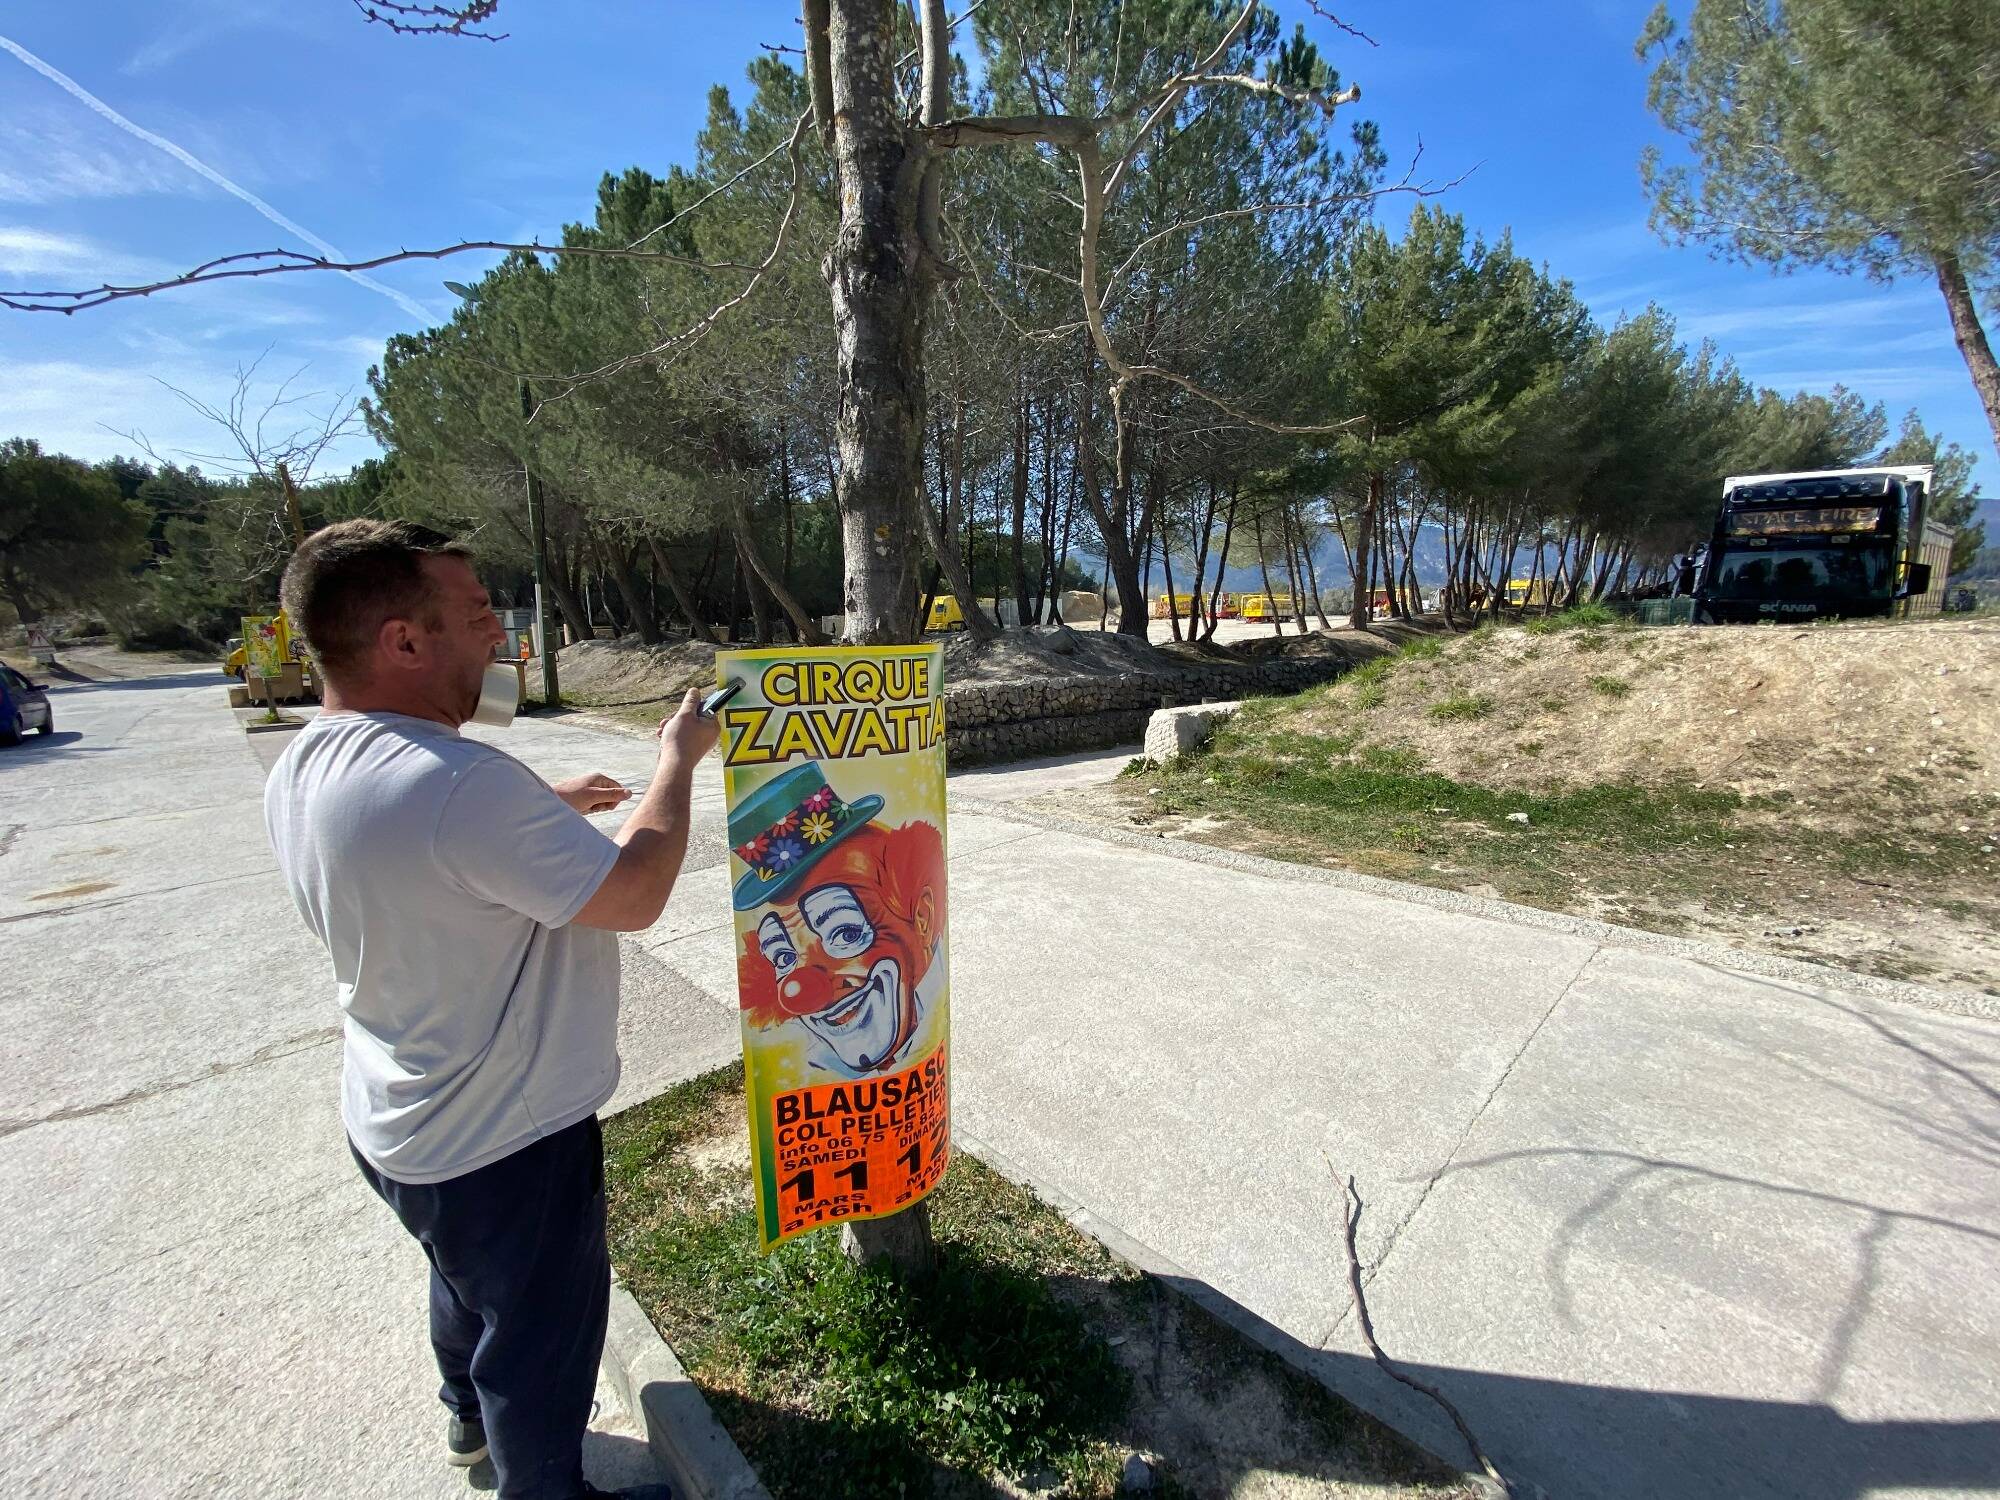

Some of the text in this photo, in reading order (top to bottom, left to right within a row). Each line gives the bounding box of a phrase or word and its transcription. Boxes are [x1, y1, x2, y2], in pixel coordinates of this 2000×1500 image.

[1759, 603, 1817, 612] SCANIA
[761, 658, 930, 706] CIRQUE
[724, 695, 946, 767] ZAVATTA
[777, 1046, 945, 1128] BLAUSASC
[778, 1121, 832, 1146] COL
[780, 1143, 820, 1161] info
[827, 1136, 853, 1149] 06
[860, 1131, 885, 1145] 75
[891, 1121, 914, 1138] 78
[784, 1147, 867, 1171] SAMEDI
[781, 1161, 868, 1201] 11
[795, 1193, 865, 1215] MARS
